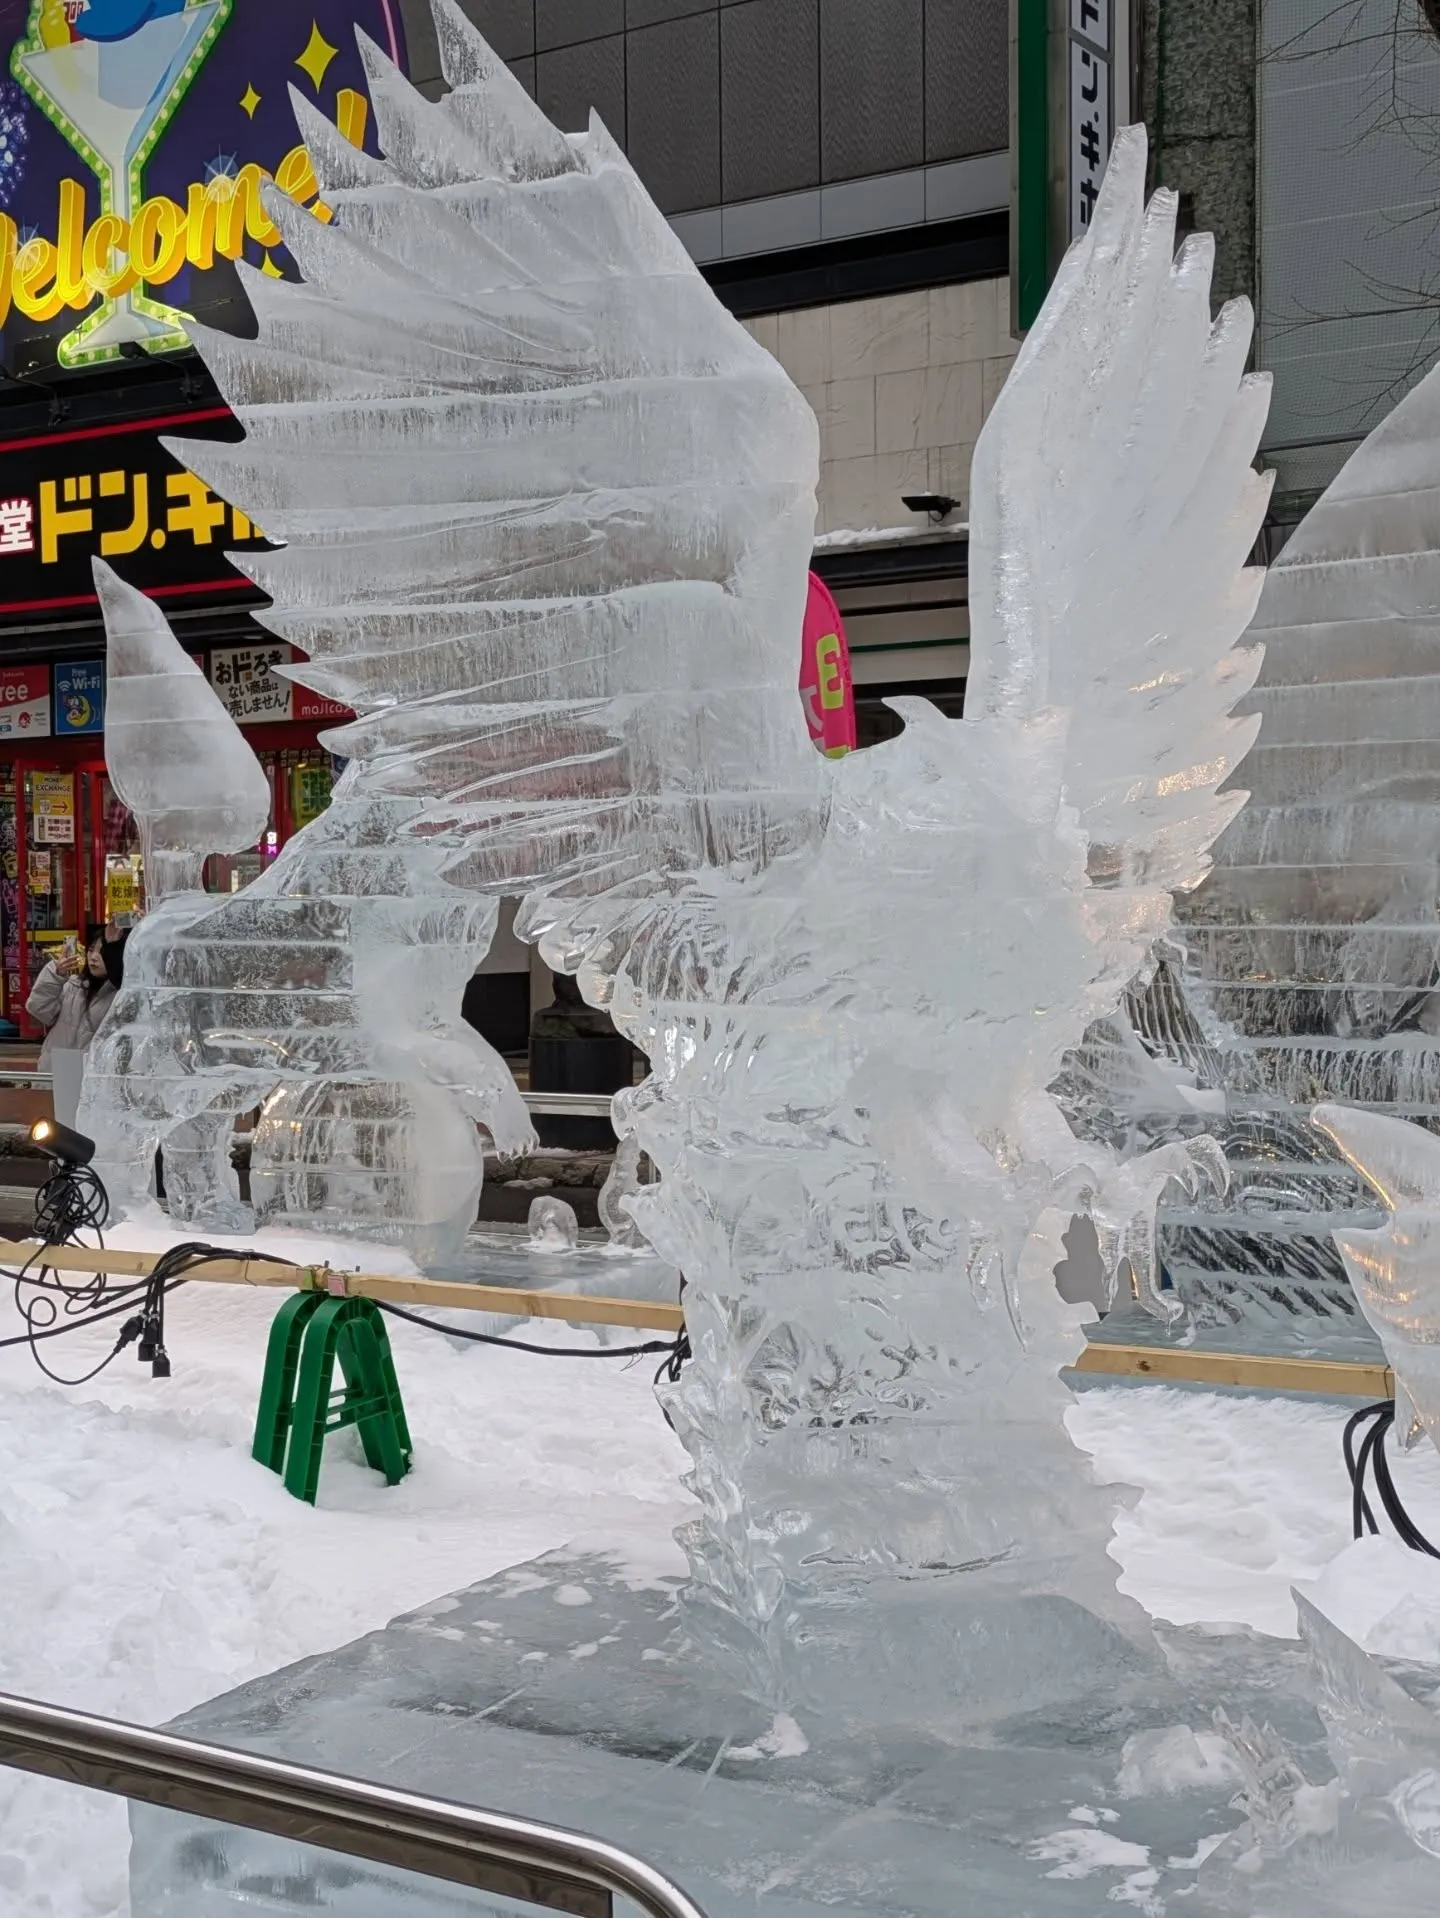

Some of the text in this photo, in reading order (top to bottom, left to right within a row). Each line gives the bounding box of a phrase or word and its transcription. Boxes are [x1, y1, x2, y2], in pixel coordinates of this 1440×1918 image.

[72, 677, 101, 690] Wi-Fi
[228, 678, 279, 699] ない商品は
[222, 690, 291, 717] 売しません!
[35, 784, 72, 792] EXCHANGE
